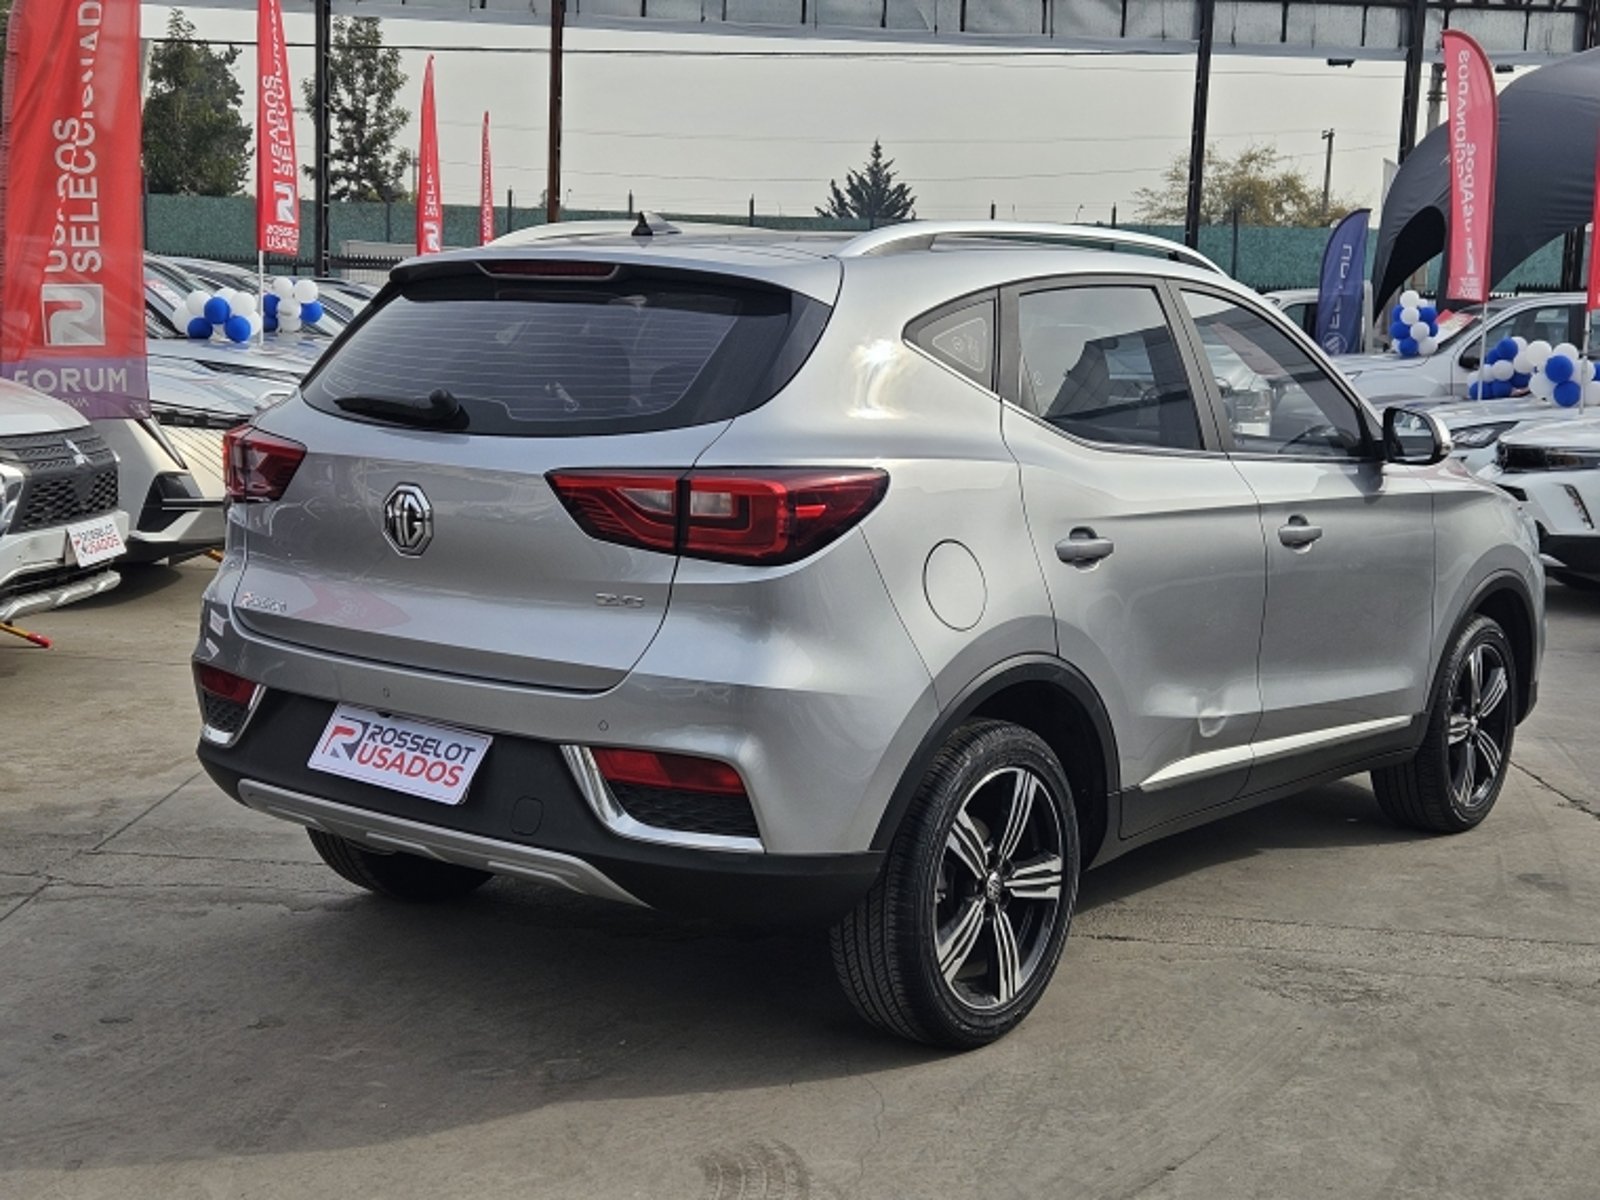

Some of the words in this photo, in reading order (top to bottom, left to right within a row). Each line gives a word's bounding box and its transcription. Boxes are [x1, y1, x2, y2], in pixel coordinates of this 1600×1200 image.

[44, 116, 80, 273] USOS
[14, 366, 128, 393] FORUM
[386, 491, 425, 549] MG
[356, 742, 465, 788] USADOS
[366, 724, 477, 765] ROSSELOT
